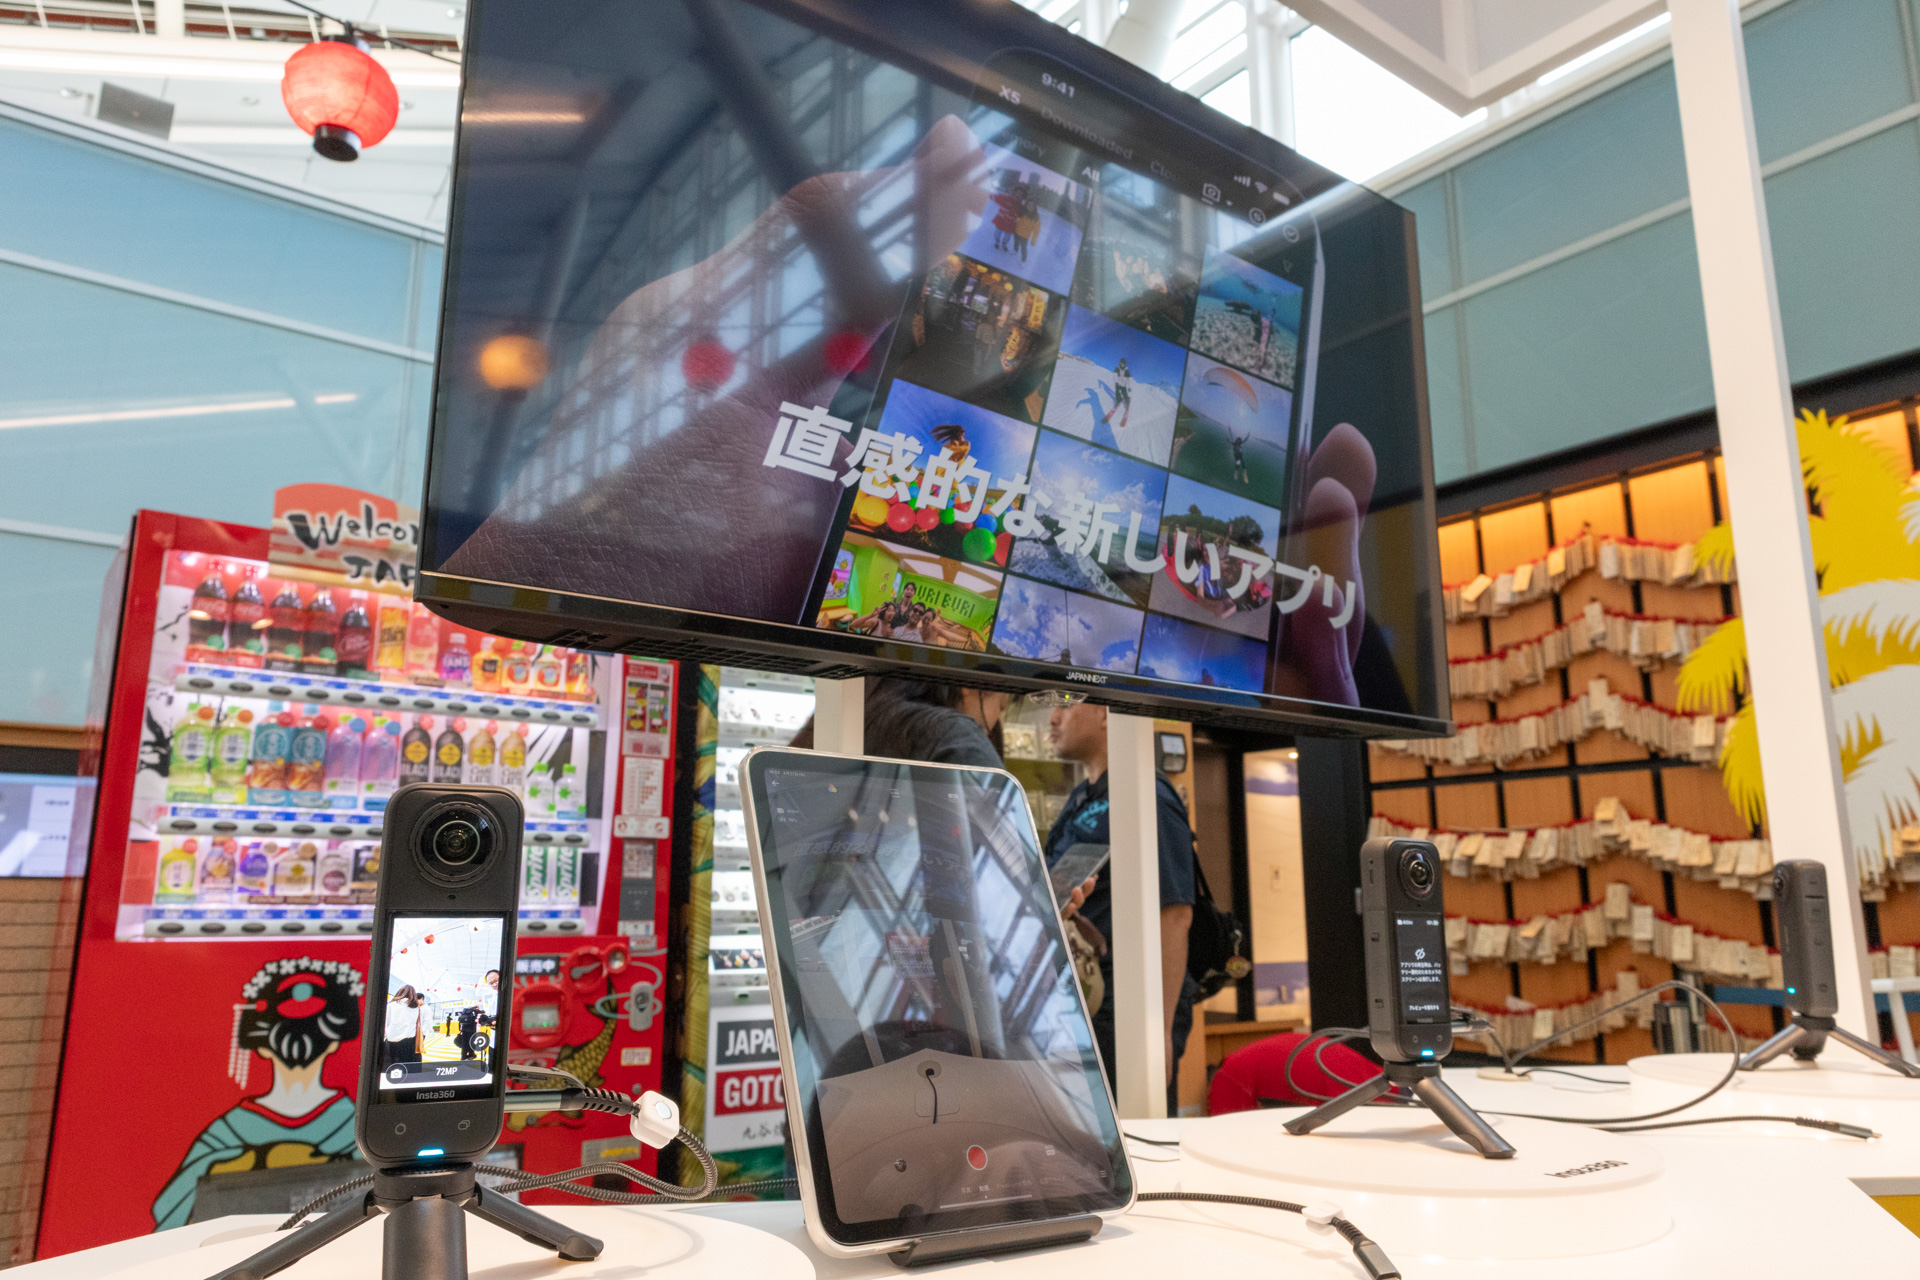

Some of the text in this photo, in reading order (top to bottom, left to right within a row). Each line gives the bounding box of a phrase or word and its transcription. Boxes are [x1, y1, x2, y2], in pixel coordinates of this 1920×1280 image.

[1042, 73, 1075, 98] 9:41
[1040, 107, 1133, 160] Downloaded
[1081, 166, 1099, 182] All
[762, 401, 1355, 629] 直感的な新しいアプリ
[941, 592, 976, 619] BURI
[1066, 671, 1109, 685] JAPANNEXT
[436, 1067, 458, 1076] 72MP
[416, 1090, 455, 1100] Insta360
